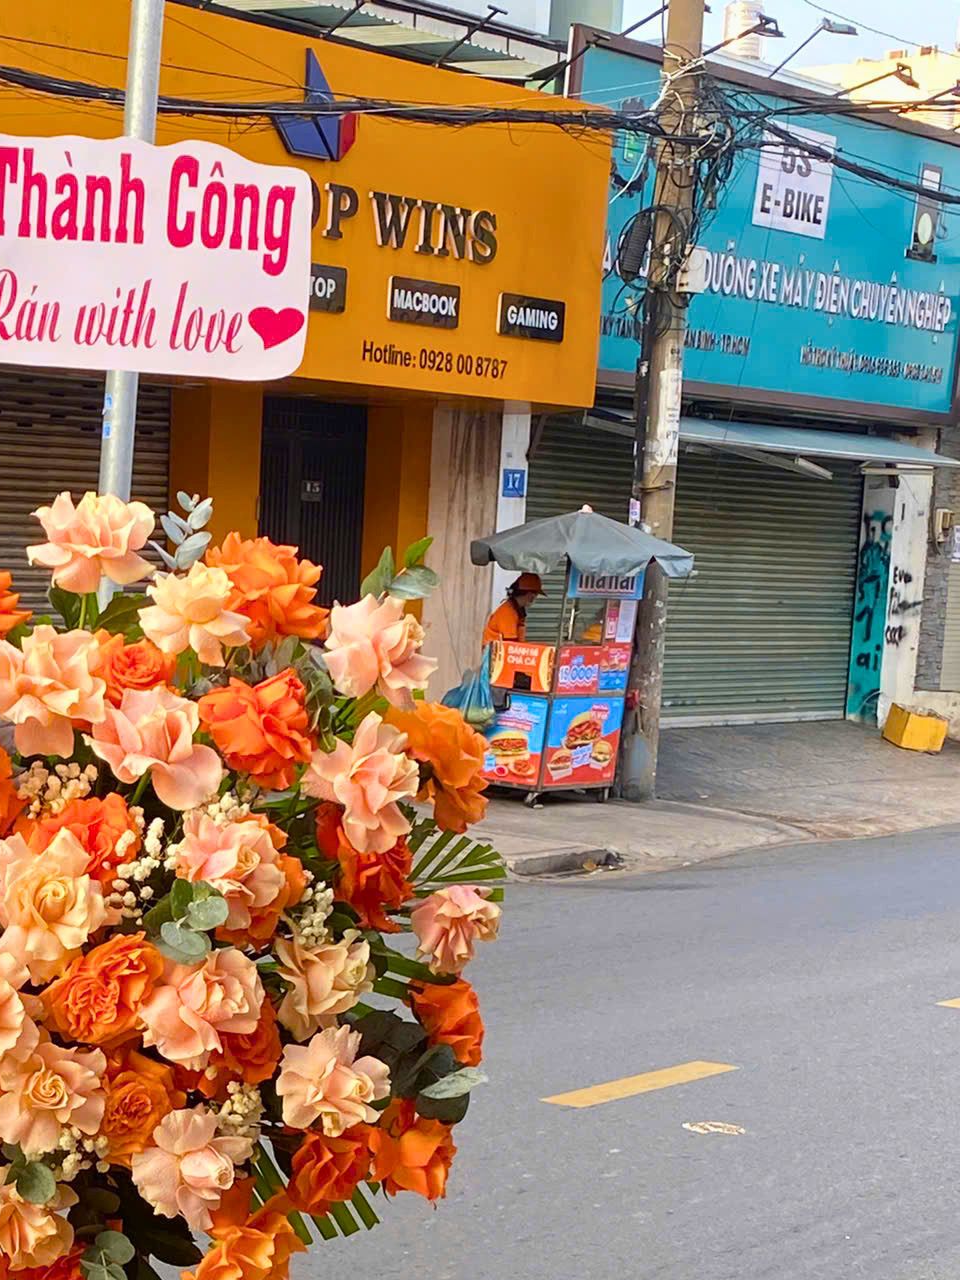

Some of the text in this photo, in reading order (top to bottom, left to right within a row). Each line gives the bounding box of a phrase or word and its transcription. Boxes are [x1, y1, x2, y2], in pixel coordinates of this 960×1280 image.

[166, 155, 296, 277] Công
[311, 178, 498, 265] P WINS
[393, 289, 458, 317] MACBOOK
[758, 261, 780, 302] XE
[781, 252, 816, 307] MÁY
[851, 270, 906, 325] CHUYÊN
[73, 278, 158, 349] with
[169, 280, 243, 354] love
[507, 305, 559, 331] GAMING
[362, 340, 416, 369] Hotline:
[419, 349, 453, 374] 0928
[507, 473, 521, 489] 17
